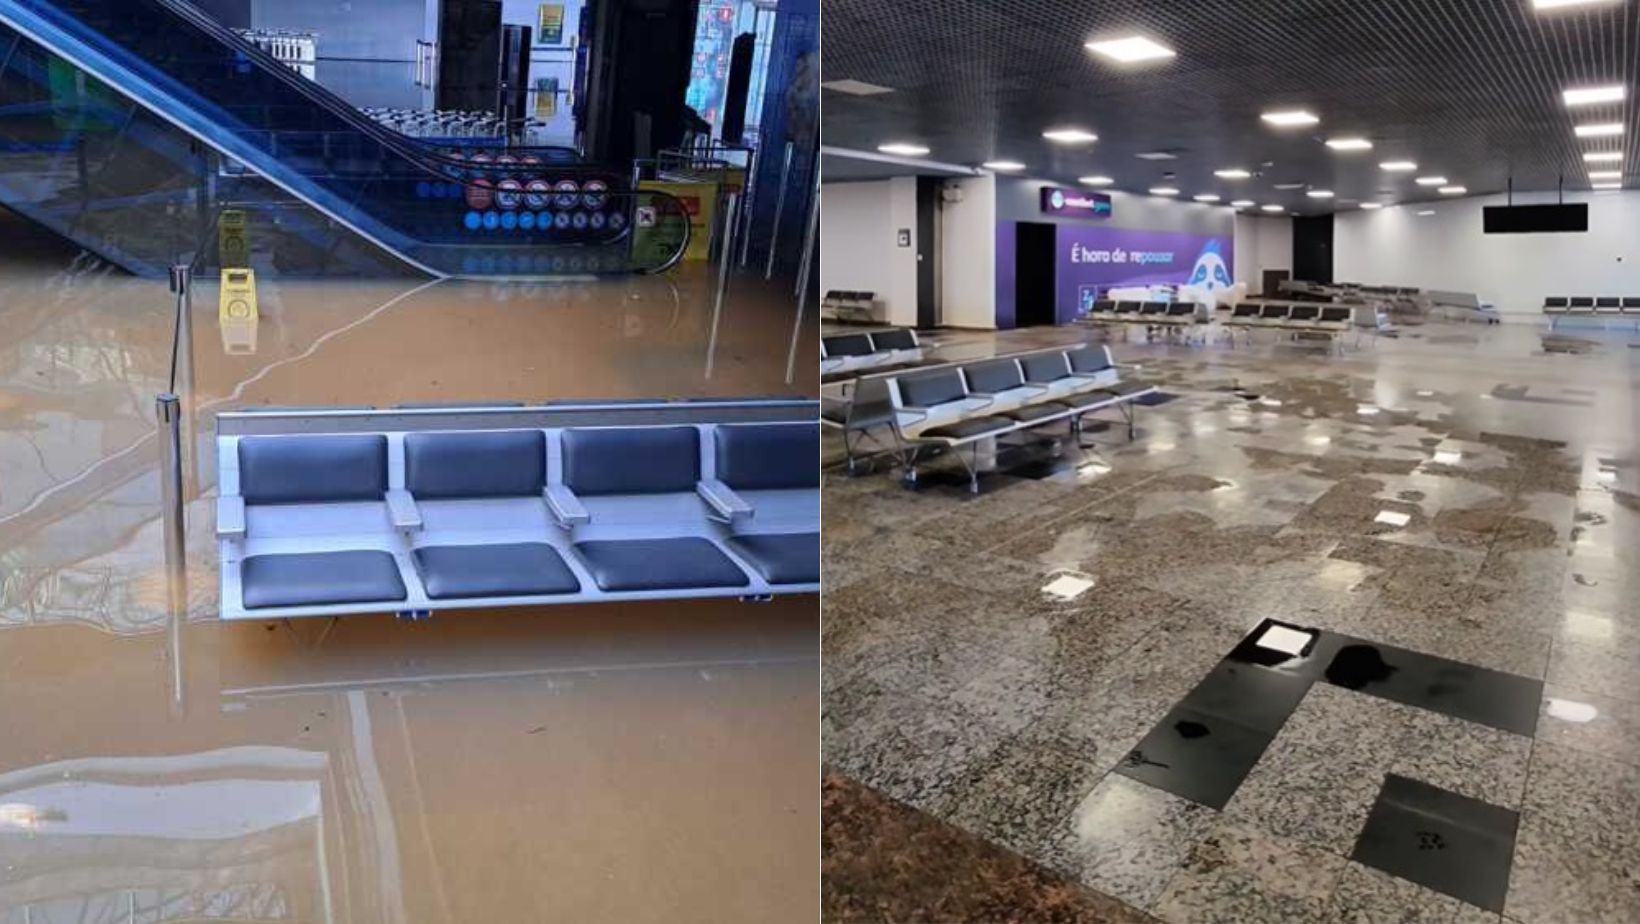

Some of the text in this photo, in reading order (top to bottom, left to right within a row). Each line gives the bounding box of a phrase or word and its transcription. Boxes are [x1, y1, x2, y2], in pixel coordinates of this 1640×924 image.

[1072, 242, 1080, 263] É
[1081, 246, 1110, 263] hora
[1111, 247, 1127, 263] de
